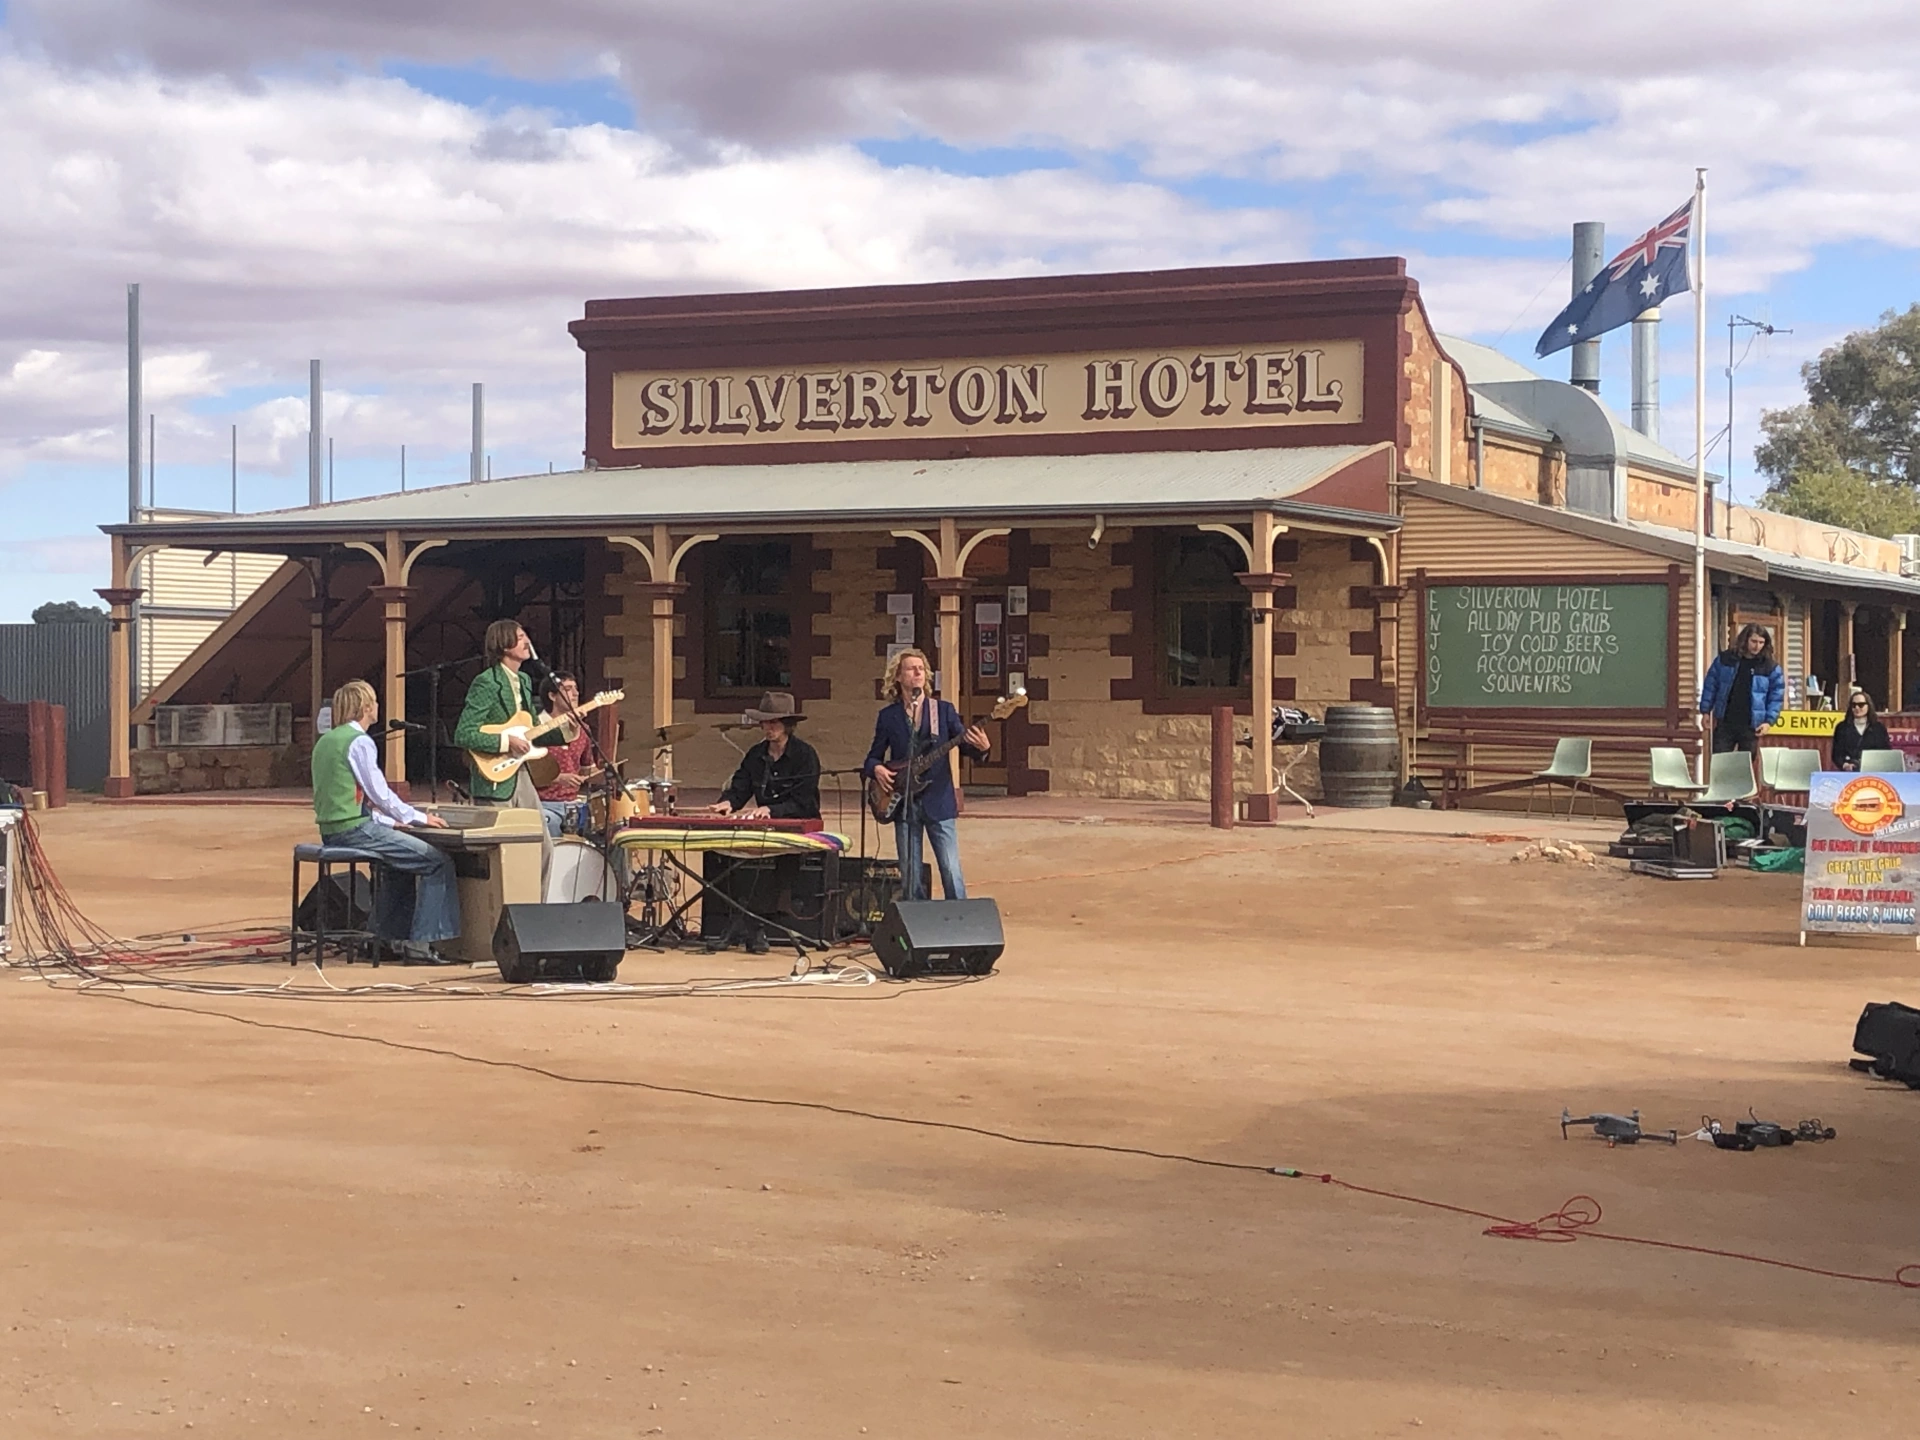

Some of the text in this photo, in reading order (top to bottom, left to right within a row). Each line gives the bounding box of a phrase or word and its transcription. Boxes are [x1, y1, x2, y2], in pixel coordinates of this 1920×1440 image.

[638, 349, 1343, 436] SILVERTON HOTEL
[1456, 586, 1614, 611] SILVERTON HOTEL
[1467, 610, 1611, 633] ALL DAY PUB GRUB
[1429, 589, 1443, 695] ENJOY
[1480, 633, 1620, 656] ICY COLD BEERS
[1476, 655, 1603, 675] ACCOMODATION
[1481, 673, 1573, 694] SOUVENIRS
[1790, 716, 1837, 730] ENTRY
[1807, 903, 1834, 922] COLD
[1836, 904, 1869, 923] BEERS
[1881, 906, 1917, 925] WINES
